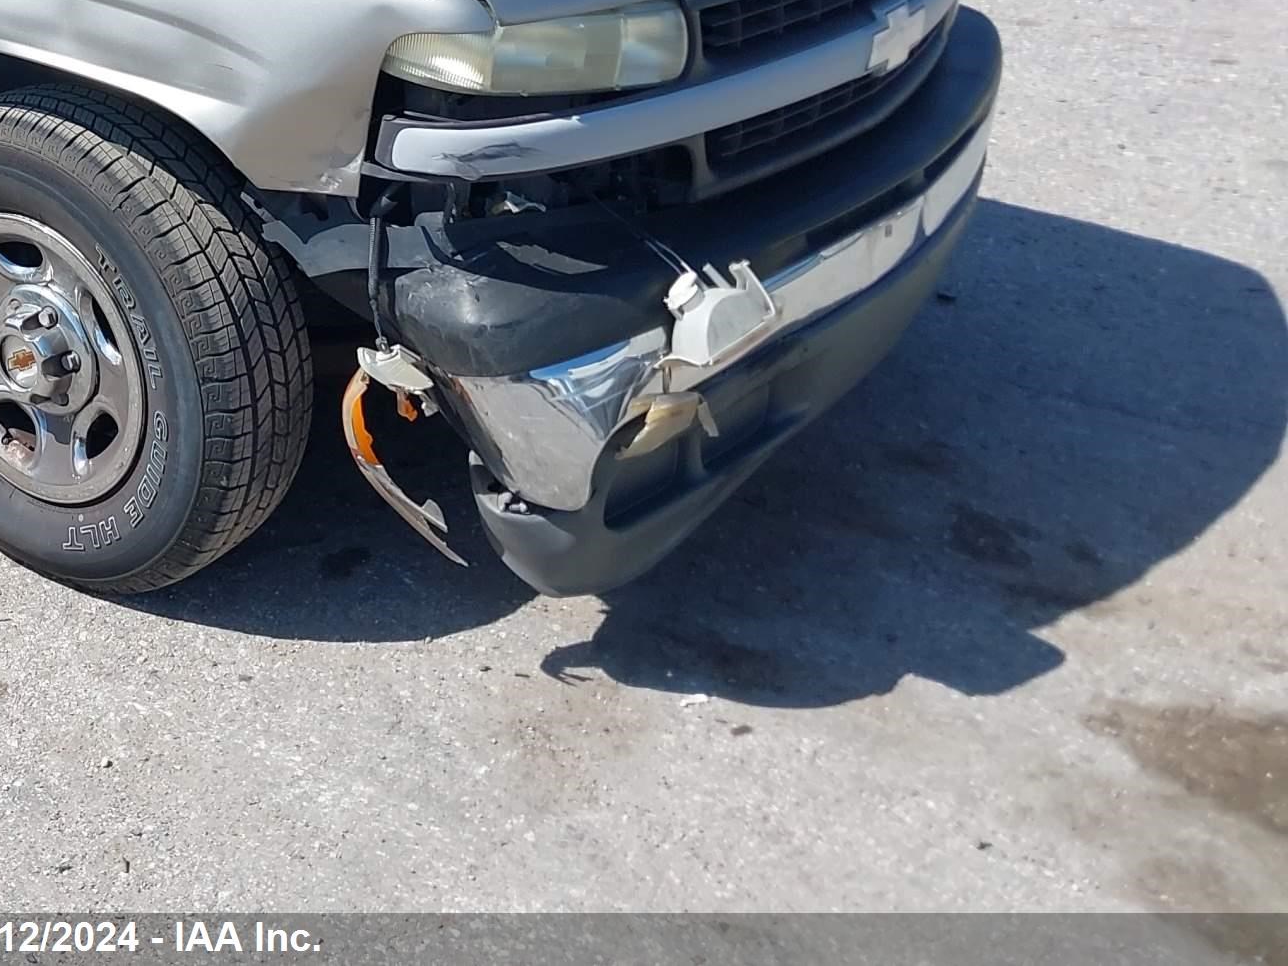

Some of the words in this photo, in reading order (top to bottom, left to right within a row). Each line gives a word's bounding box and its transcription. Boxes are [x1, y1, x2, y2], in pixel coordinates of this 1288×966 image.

[95, 242, 164, 389] TRAIL
[124, 410, 169, 527] GUIDE
[62, 516, 121, 552] HLT
